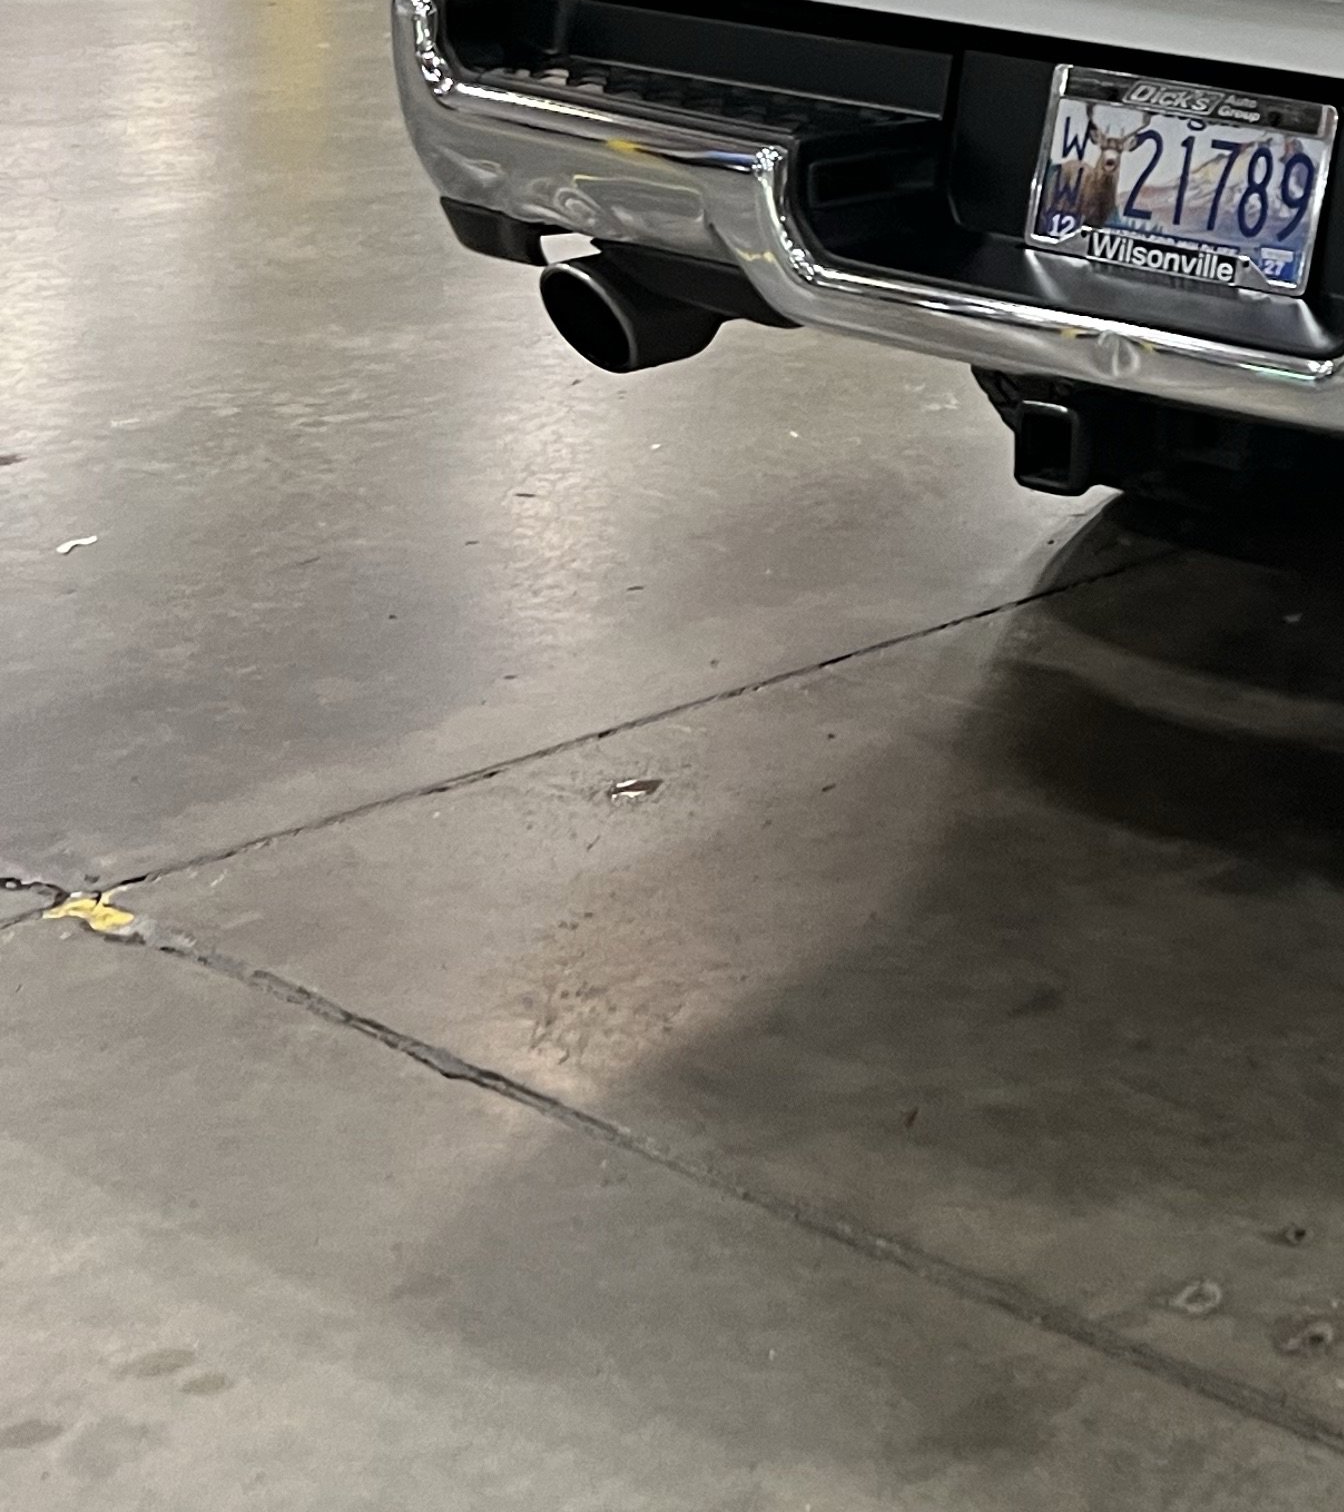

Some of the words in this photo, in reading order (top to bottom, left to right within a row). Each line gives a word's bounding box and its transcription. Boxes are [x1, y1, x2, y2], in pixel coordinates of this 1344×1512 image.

[1218, 105, 1261, 123] Group
[1123, 129, 1316, 242] 21789
[1048, 214, 1076, 237] 12
[1091, 232, 1233, 281] Wilsonville
[1262, 260, 1285, 276] 27
